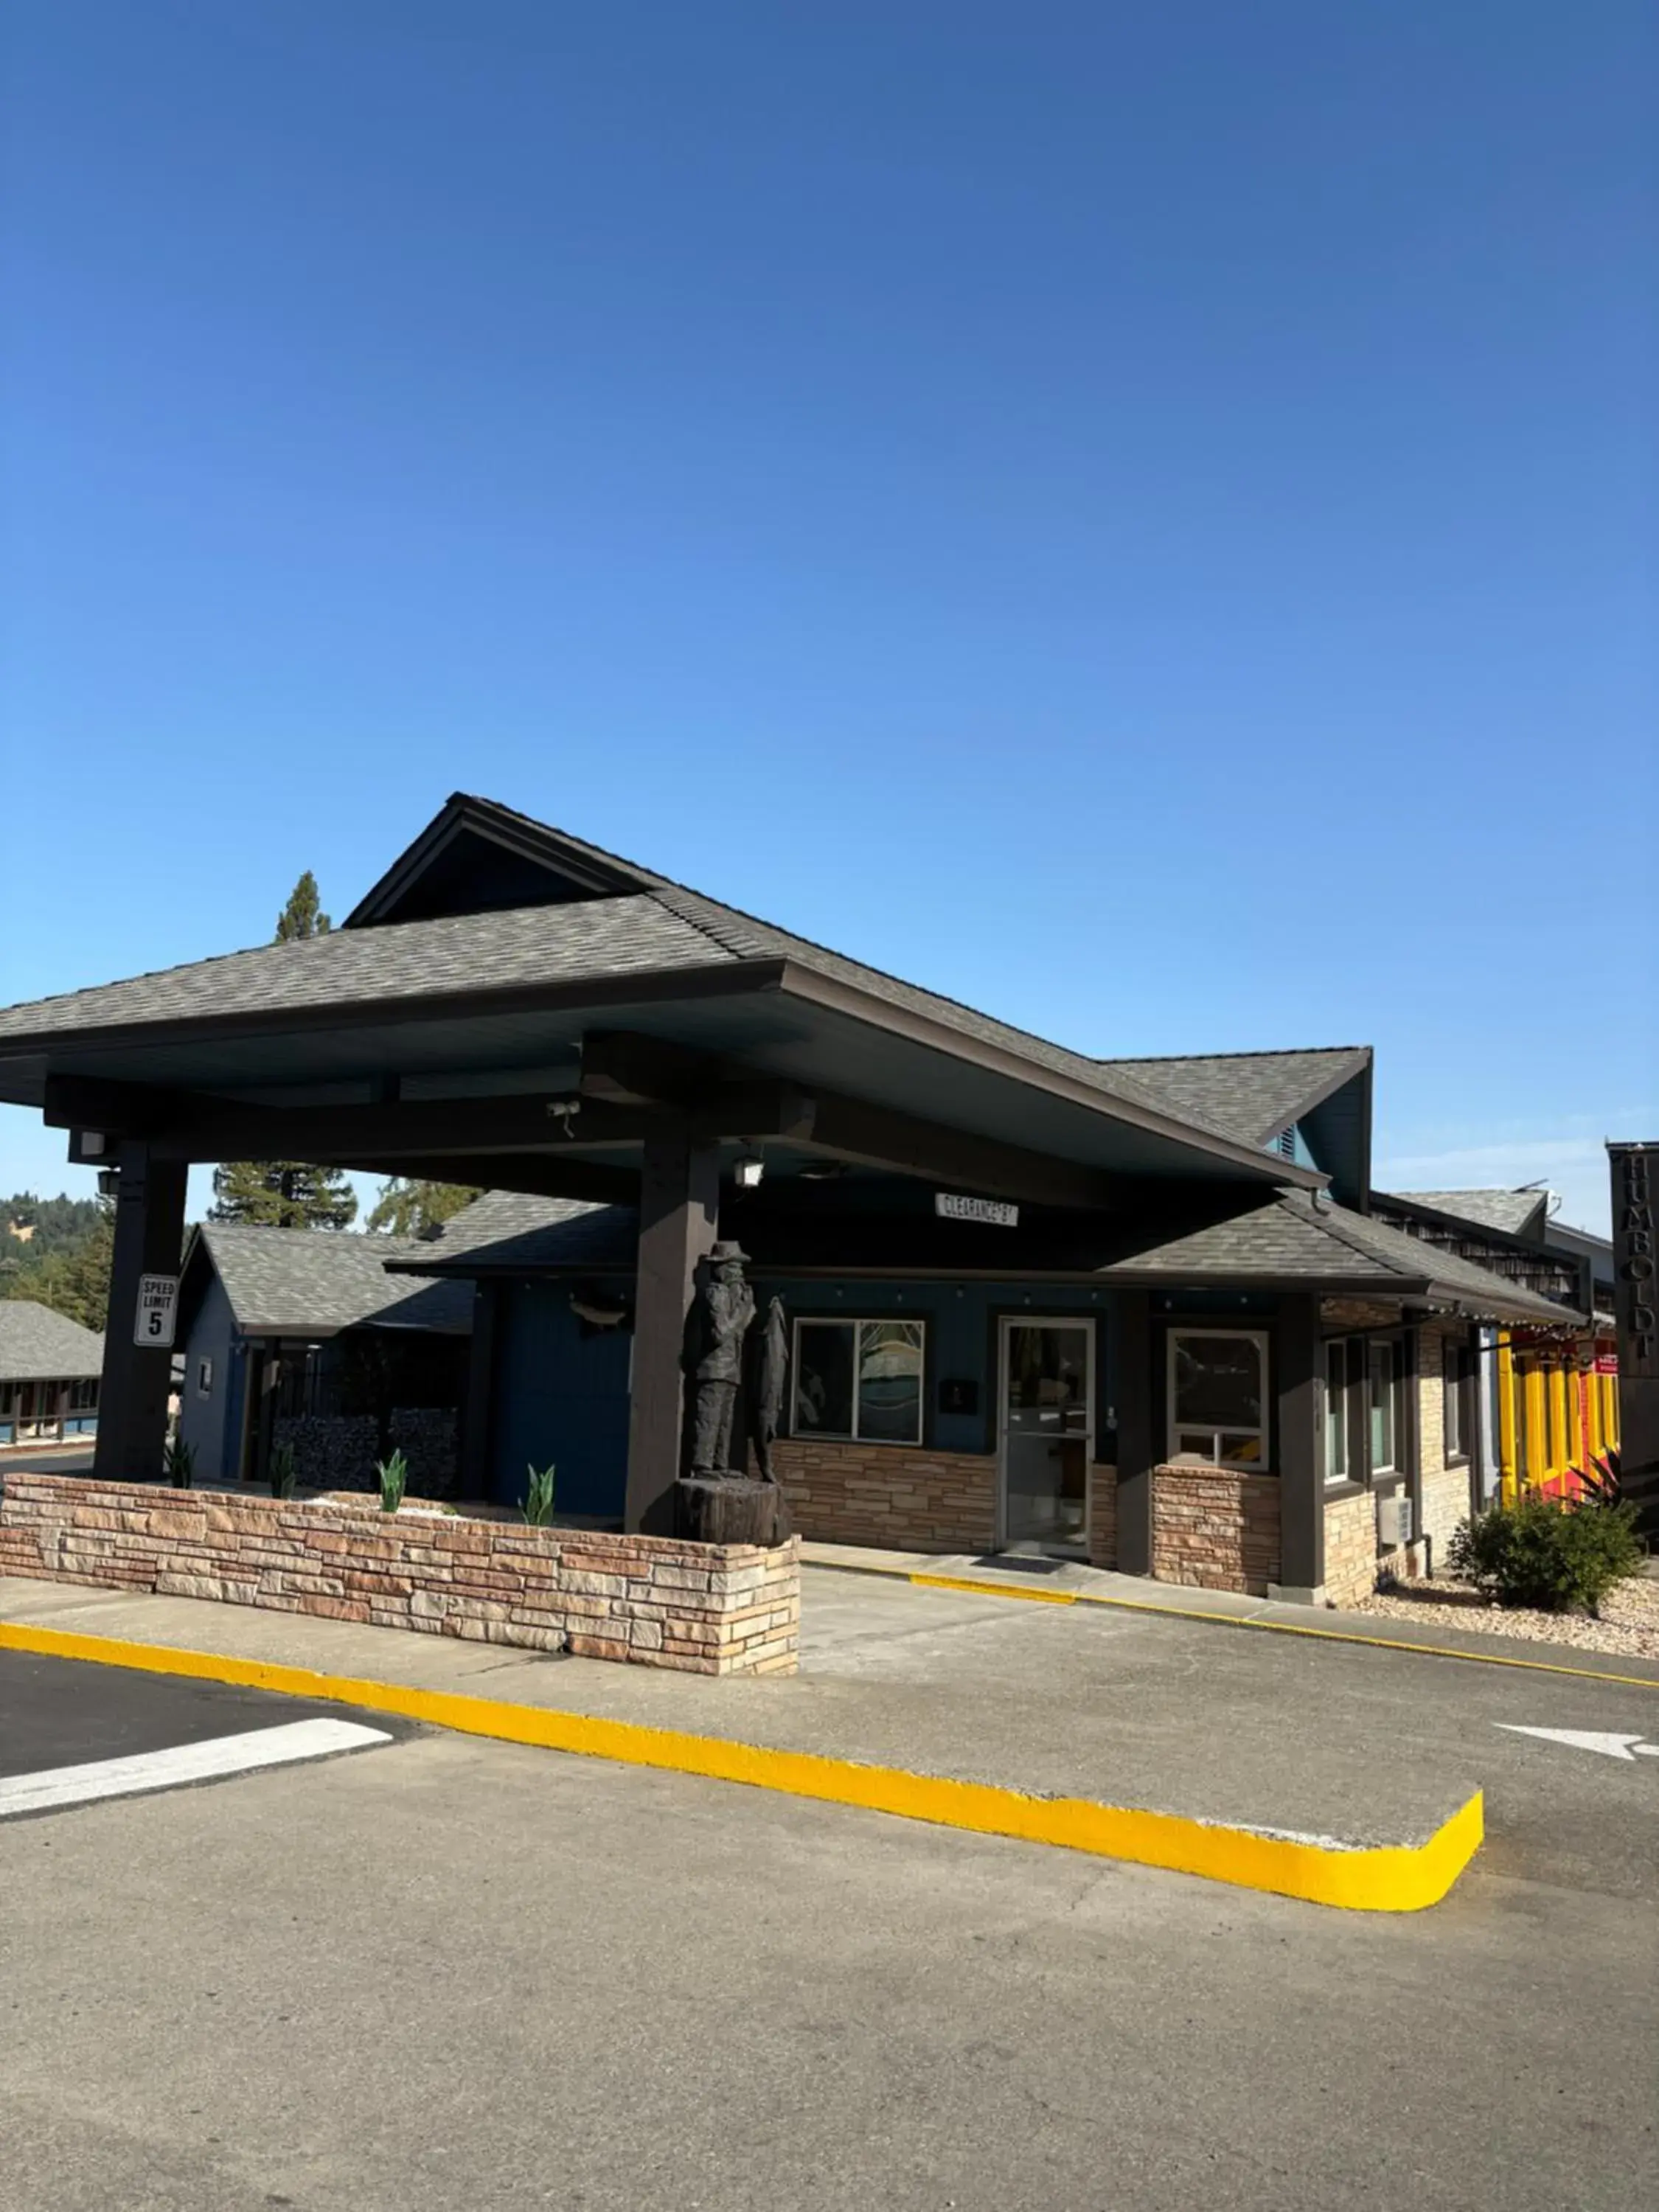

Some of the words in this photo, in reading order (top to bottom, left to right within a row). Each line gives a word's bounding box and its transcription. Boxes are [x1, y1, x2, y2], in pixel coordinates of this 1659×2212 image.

[944, 1195, 998, 1221] CLEARANCE
[1624, 1155, 1655, 1360] HUMBOLDT
[144, 1280, 175, 1295] SPEED
[143, 1295, 171, 1310] LIMIT
[148, 1311, 163, 1336] 5
